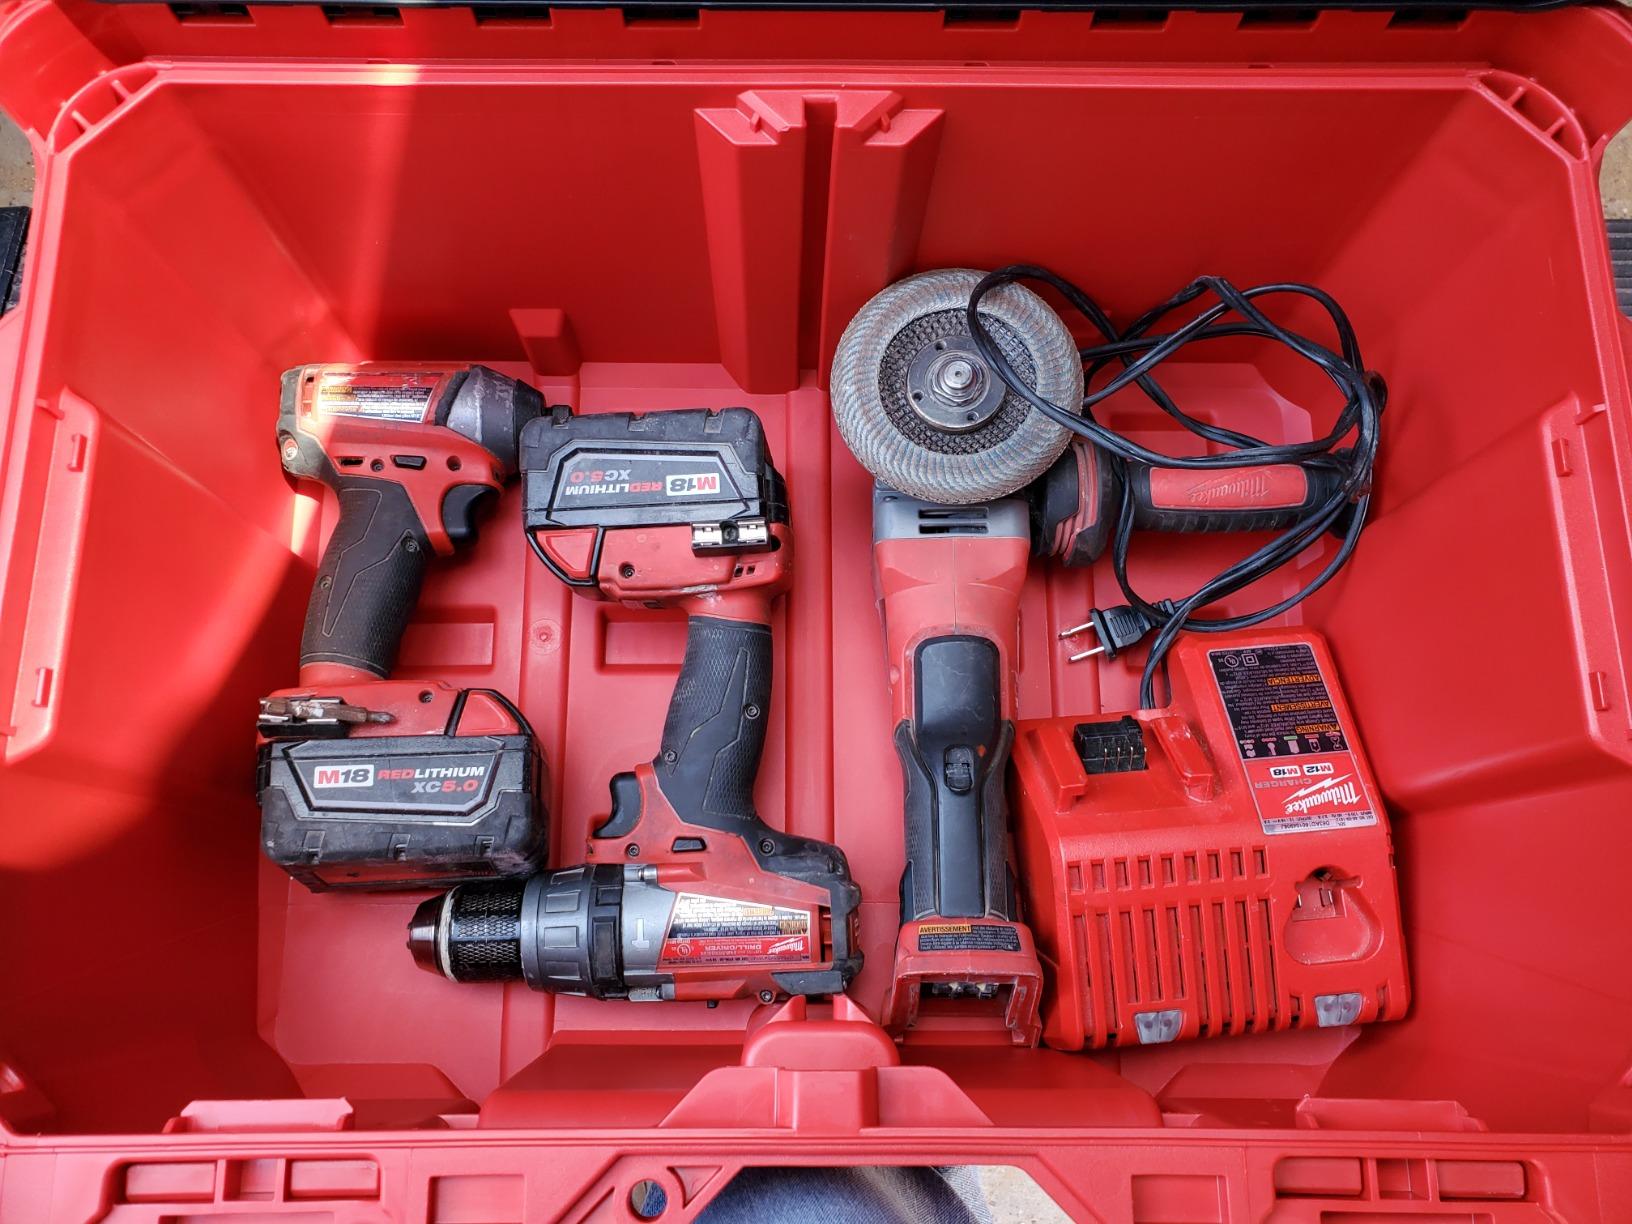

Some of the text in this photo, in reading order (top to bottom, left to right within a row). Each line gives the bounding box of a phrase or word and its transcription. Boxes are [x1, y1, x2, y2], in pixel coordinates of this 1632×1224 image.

[570, 469, 631, 483] XC5.0
[565, 476, 717, 495] M18 REDLITHIUM
[1191, 475, 1270, 504] Milwaukee
[1268, 675, 1320, 685] ADVERTENCIA
[1272, 701, 1330, 711] AVERTISSEMENT
[1296, 724, 1332, 733] WARNING
[317, 766, 485, 785] M18 REDLITHIUM
[1273, 763, 1331, 776] M12 M18
[411, 779, 480, 793] XC5.0
[1254, 778, 1312, 788] CHARGER
[1284, 782, 1361, 814] Milwaukee
[920, 925, 970, 933] AVERTISSEMENT
[768, 940, 804, 954] Milwaukee
